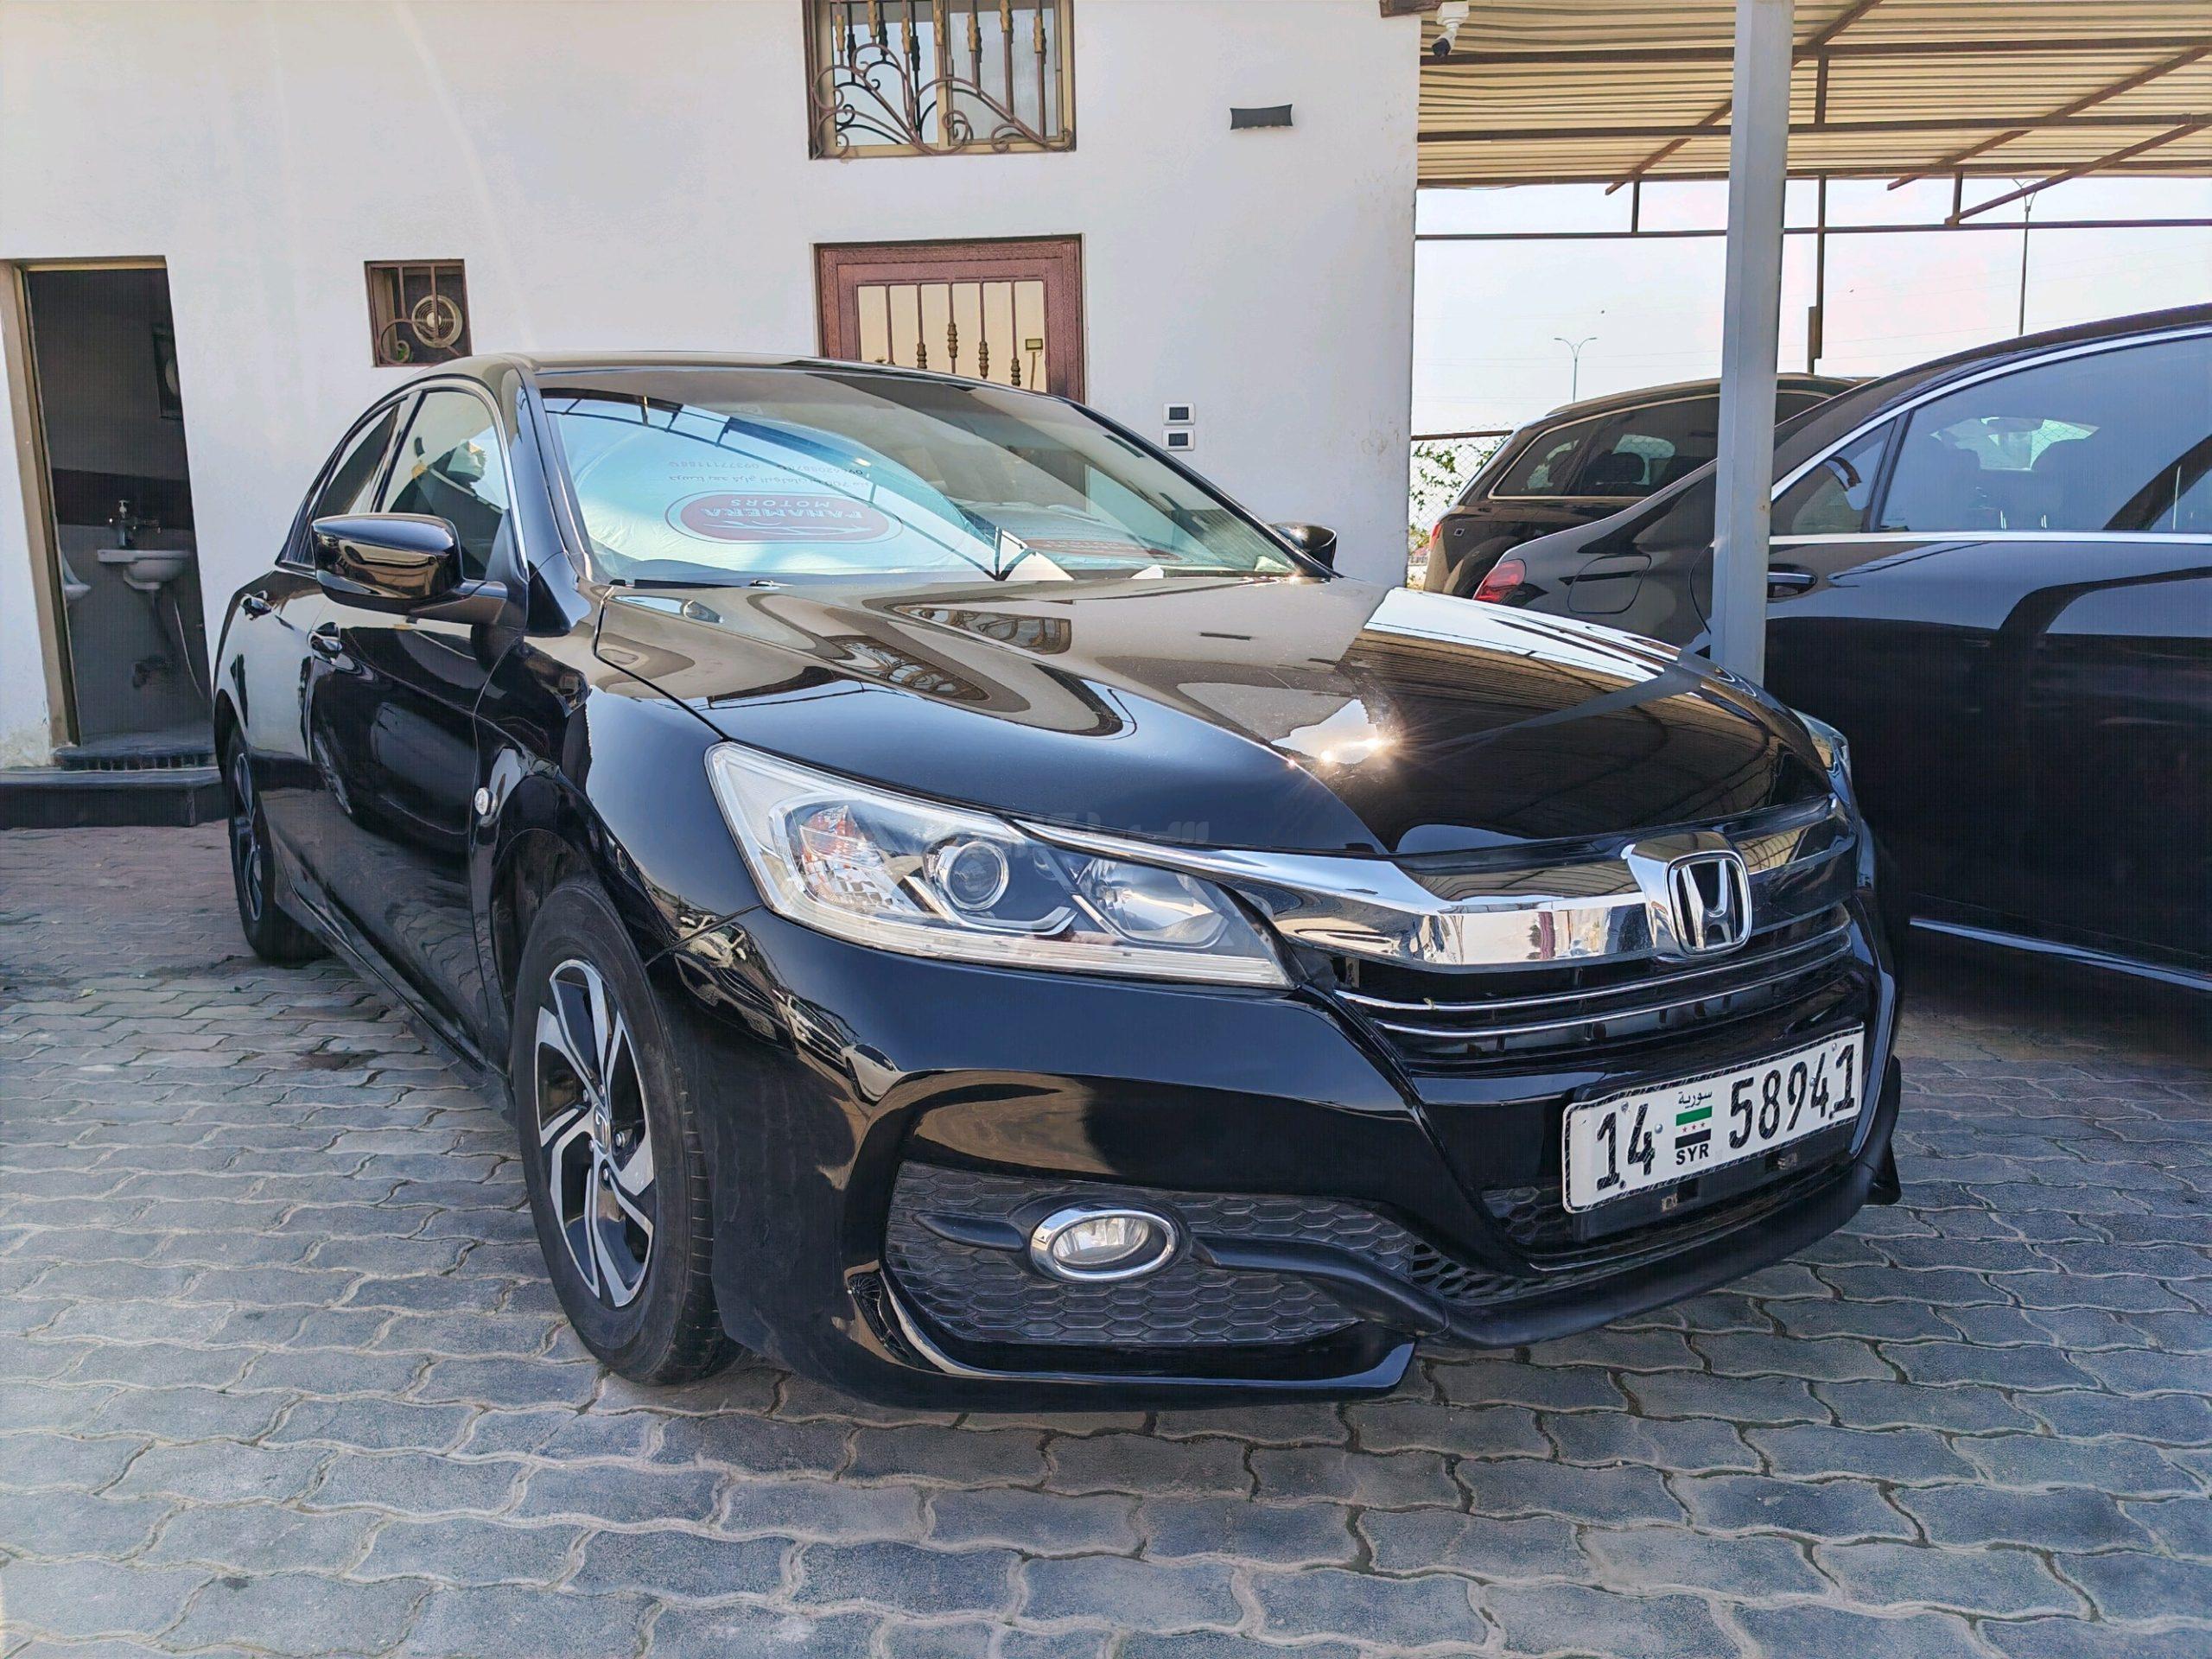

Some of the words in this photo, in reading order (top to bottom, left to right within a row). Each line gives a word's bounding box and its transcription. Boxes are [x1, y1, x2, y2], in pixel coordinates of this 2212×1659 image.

[702, 506, 864, 519] PANAMERA
[730, 499, 830, 508] MOTORS
[1678, 1090, 1713, 1109] سورية
[1596, 1103, 1656, 1192] 14
[1728, 1043, 1856, 1149] 58941
[1675, 1143, 1709, 1166] SYR
